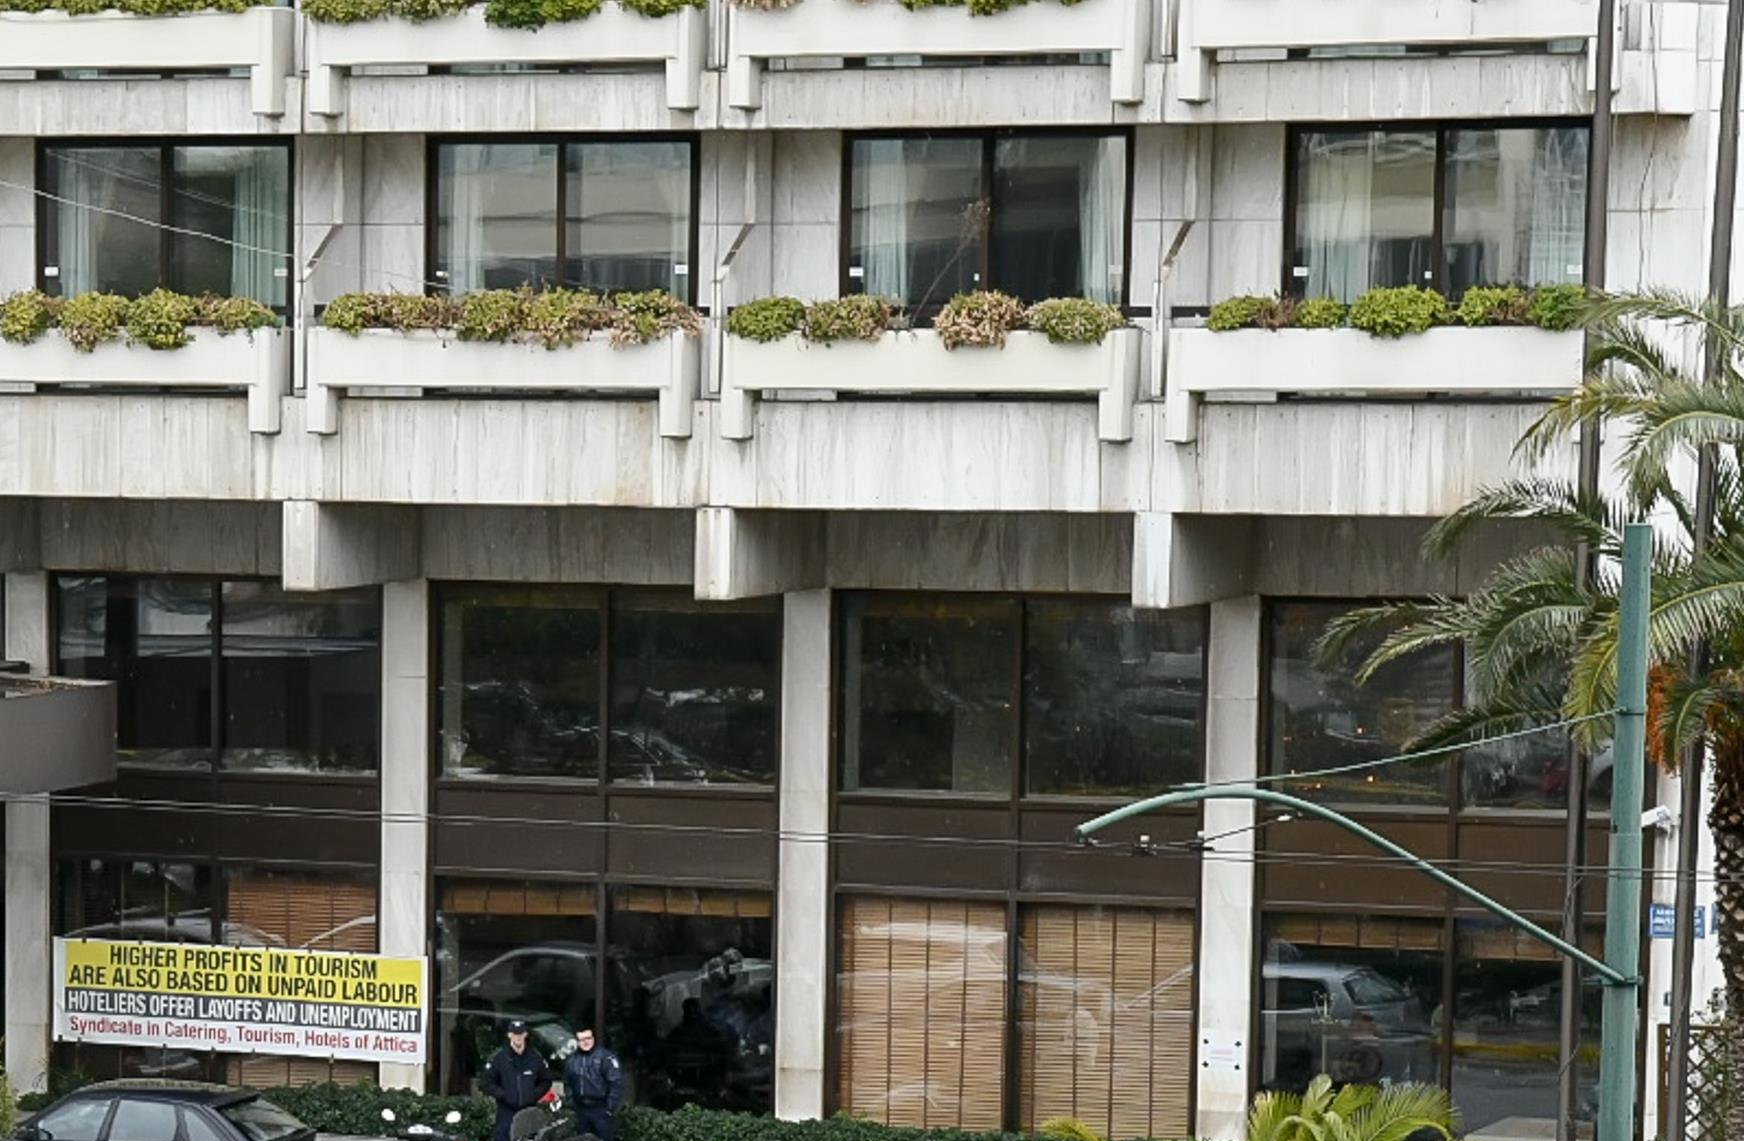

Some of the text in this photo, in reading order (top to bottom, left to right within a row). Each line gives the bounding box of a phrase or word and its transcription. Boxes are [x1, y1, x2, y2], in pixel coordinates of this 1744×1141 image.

[110, 945, 377, 979] HIGHER PROFITS IN TOURISM
[69, 964, 417, 1004] ARE ALSO BASED ON UNPAID LABOUR
[68, 990, 417, 1031] HOTELIERS OFFER LAYOFFS AND UNEMPLOYMENT
[70, 1015, 417, 1053] Syndicate in Catering, Tourism, Hotels of Attica
